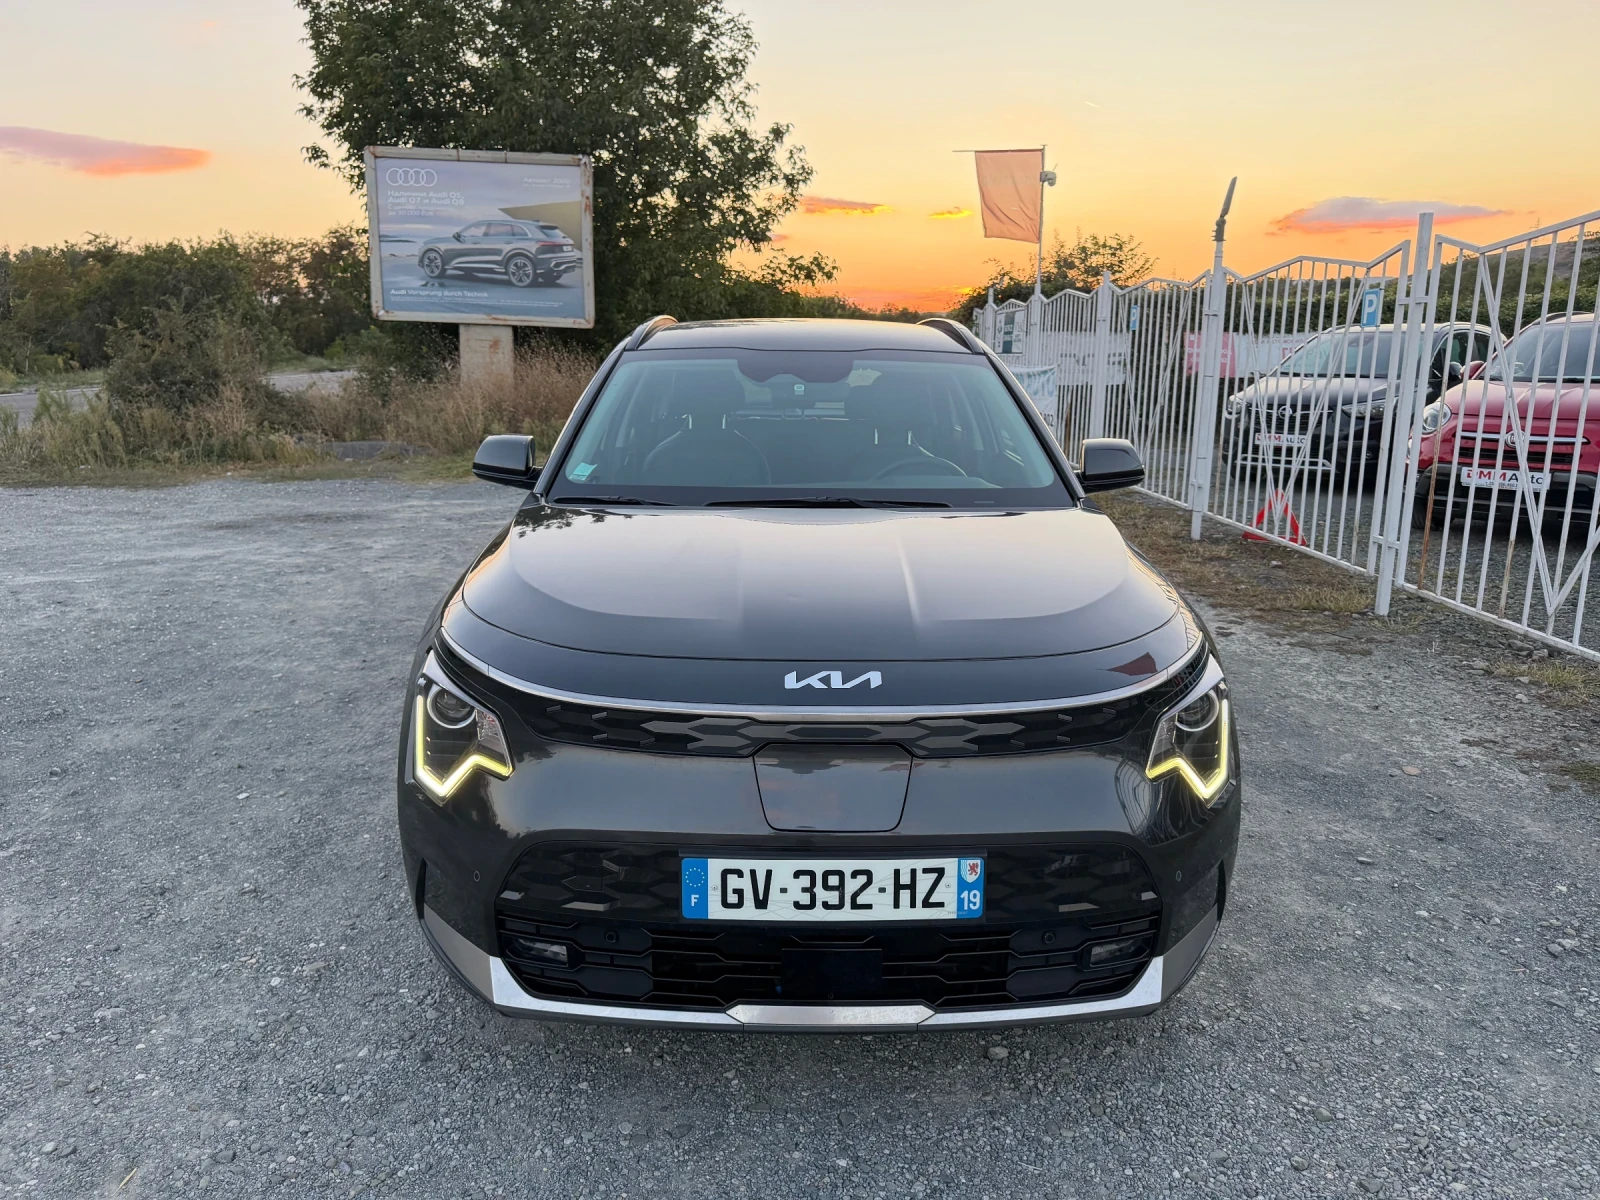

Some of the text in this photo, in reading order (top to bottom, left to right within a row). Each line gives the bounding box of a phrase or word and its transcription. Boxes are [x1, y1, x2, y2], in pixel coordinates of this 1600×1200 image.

[407, 289, 443, 297] Vorsprung
[1363, 294, 1377, 324] P
[784, 671, 882, 689] KIA
[720, 867, 945, 910] GV-392-HZ
[691, 895, 699, 907] F
[960, 889, 980, 910] 19
